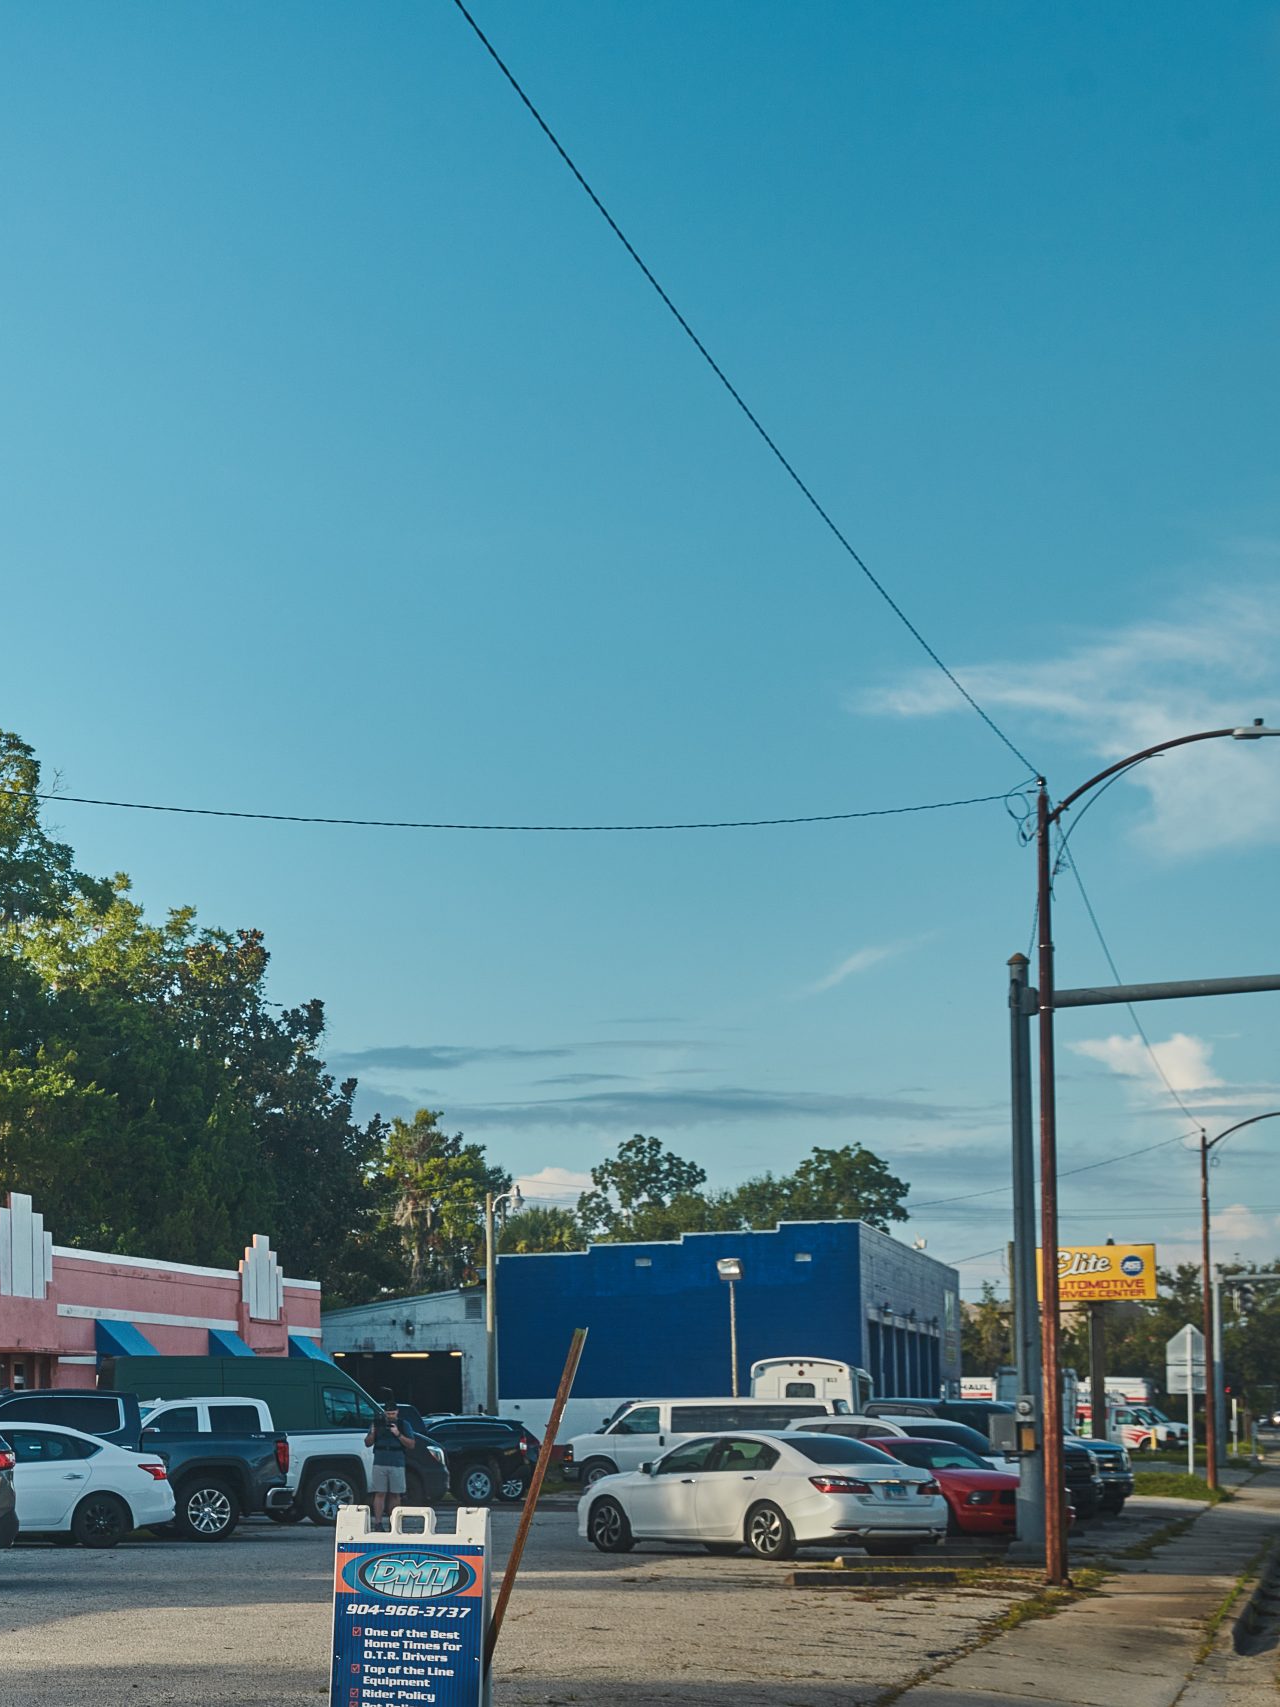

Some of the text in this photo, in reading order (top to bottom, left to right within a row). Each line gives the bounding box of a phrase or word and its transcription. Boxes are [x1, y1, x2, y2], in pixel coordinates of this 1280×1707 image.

[1059, 1279, 1144, 1289] UTOMOTIVE
[1059, 1290, 1096, 1298] RVICE
[371, 1559, 460, 1586] DMT
[346, 1604, 471, 1618] 904-966-3737
[364, 1628, 460, 1639] One of the Best
[364, 1639, 462, 1651] Home Times for
[363, 1650, 448, 1662] O.T.R. Drivers
[363, 1664, 386, 1675] Top
[403, 1666, 425, 1675] the
[427, 1667, 455, 1676] Line
[363, 1676, 431, 1687] Equipment
[362, 1689, 436, 1703] Rider Policy
